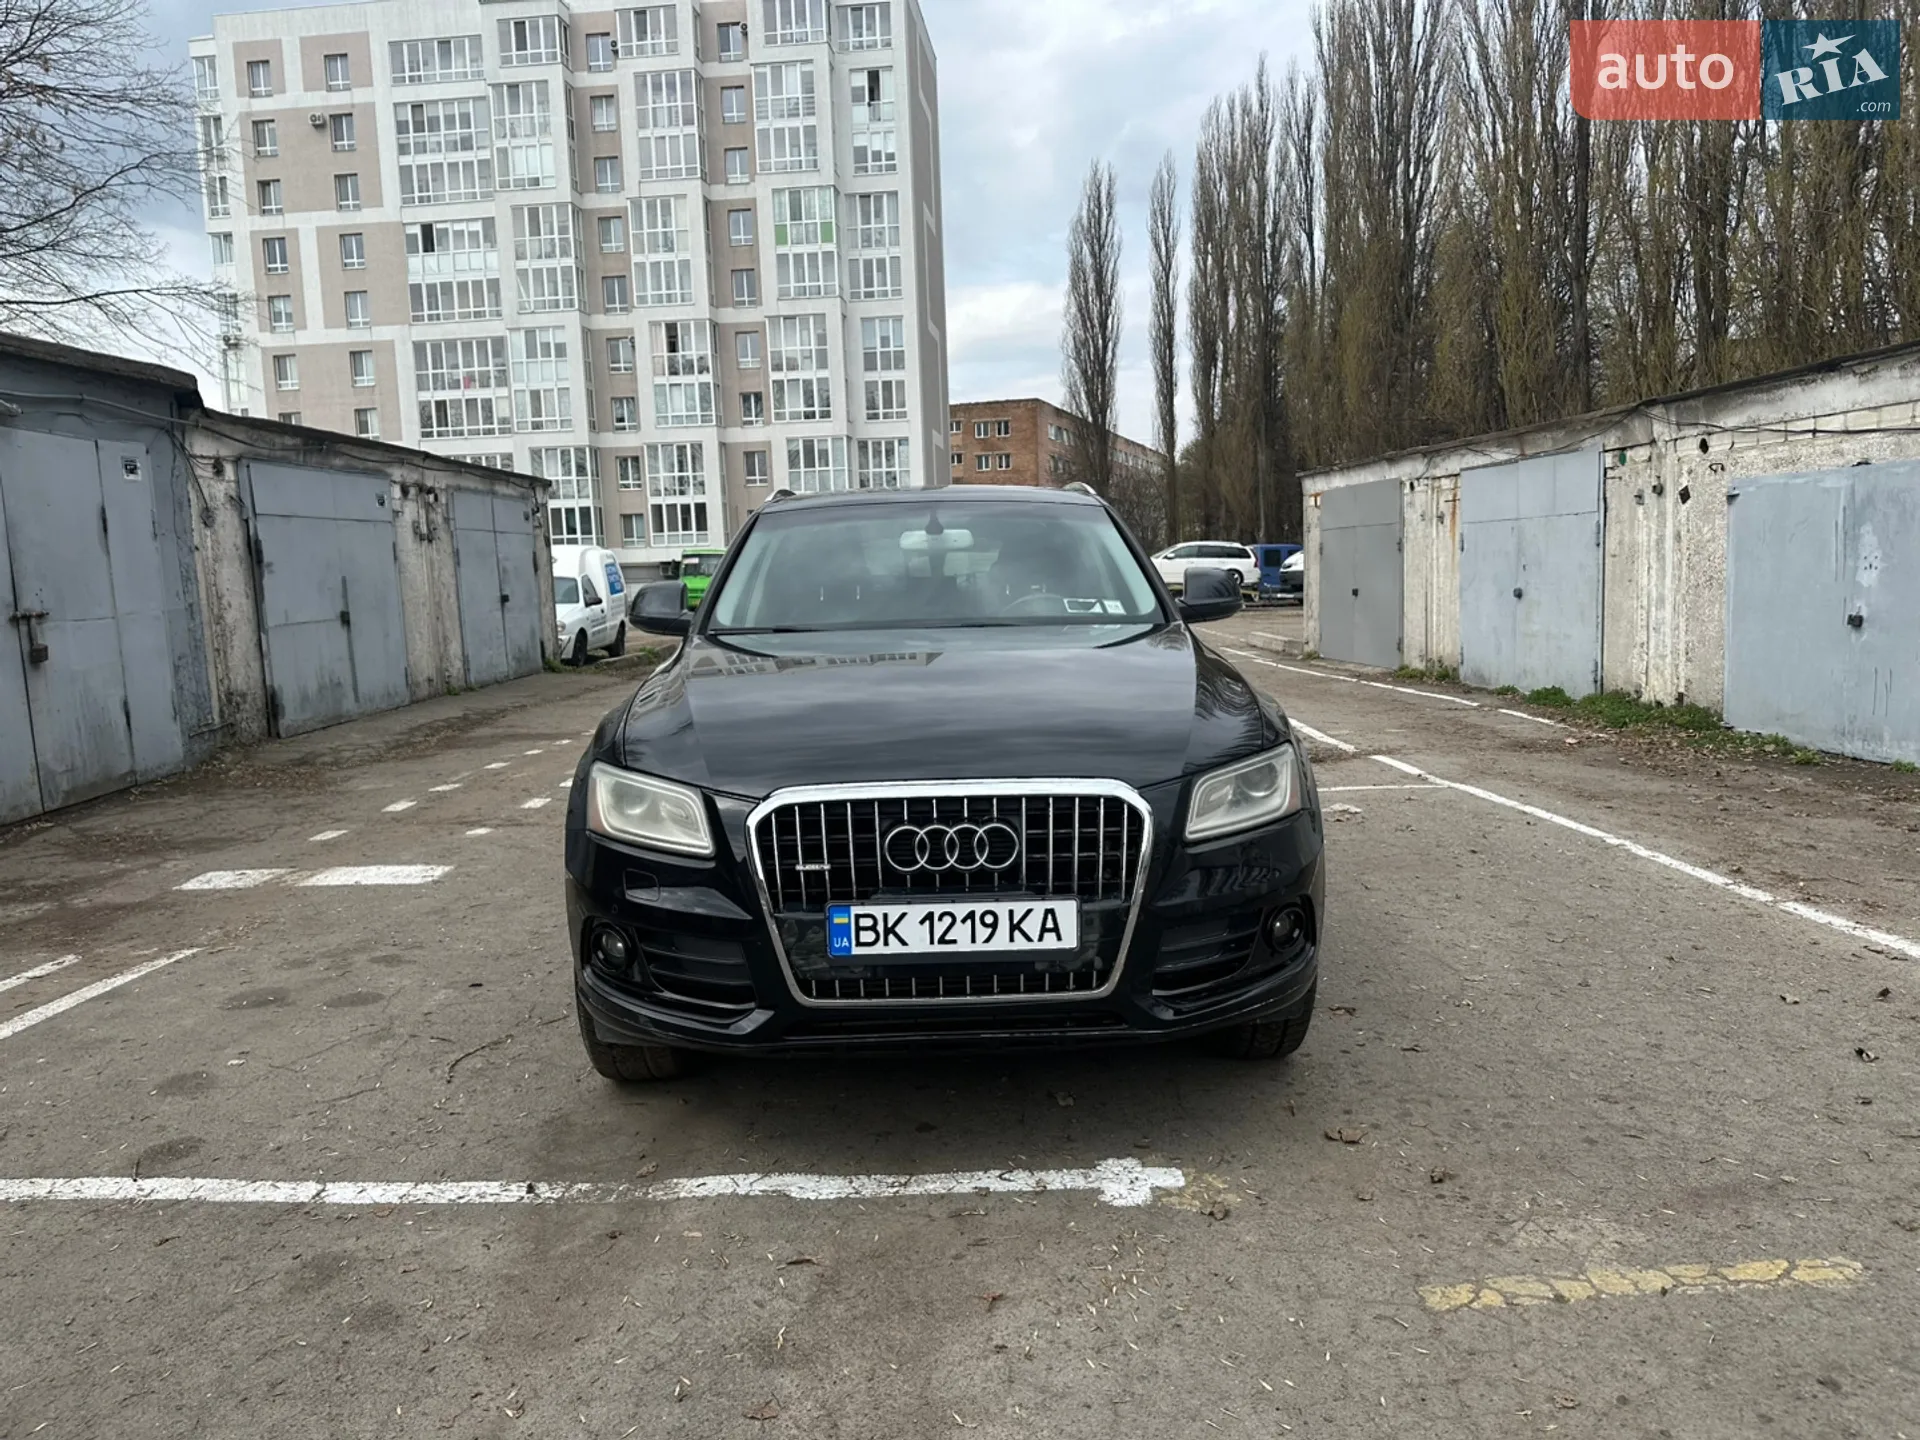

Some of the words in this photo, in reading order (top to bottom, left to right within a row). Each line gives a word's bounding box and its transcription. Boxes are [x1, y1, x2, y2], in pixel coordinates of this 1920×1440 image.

[854, 912, 909, 948] BK
[918, 909, 999, 946] 1219
[1008, 907, 1063, 943] KA
[833, 937, 850, 948] UA
